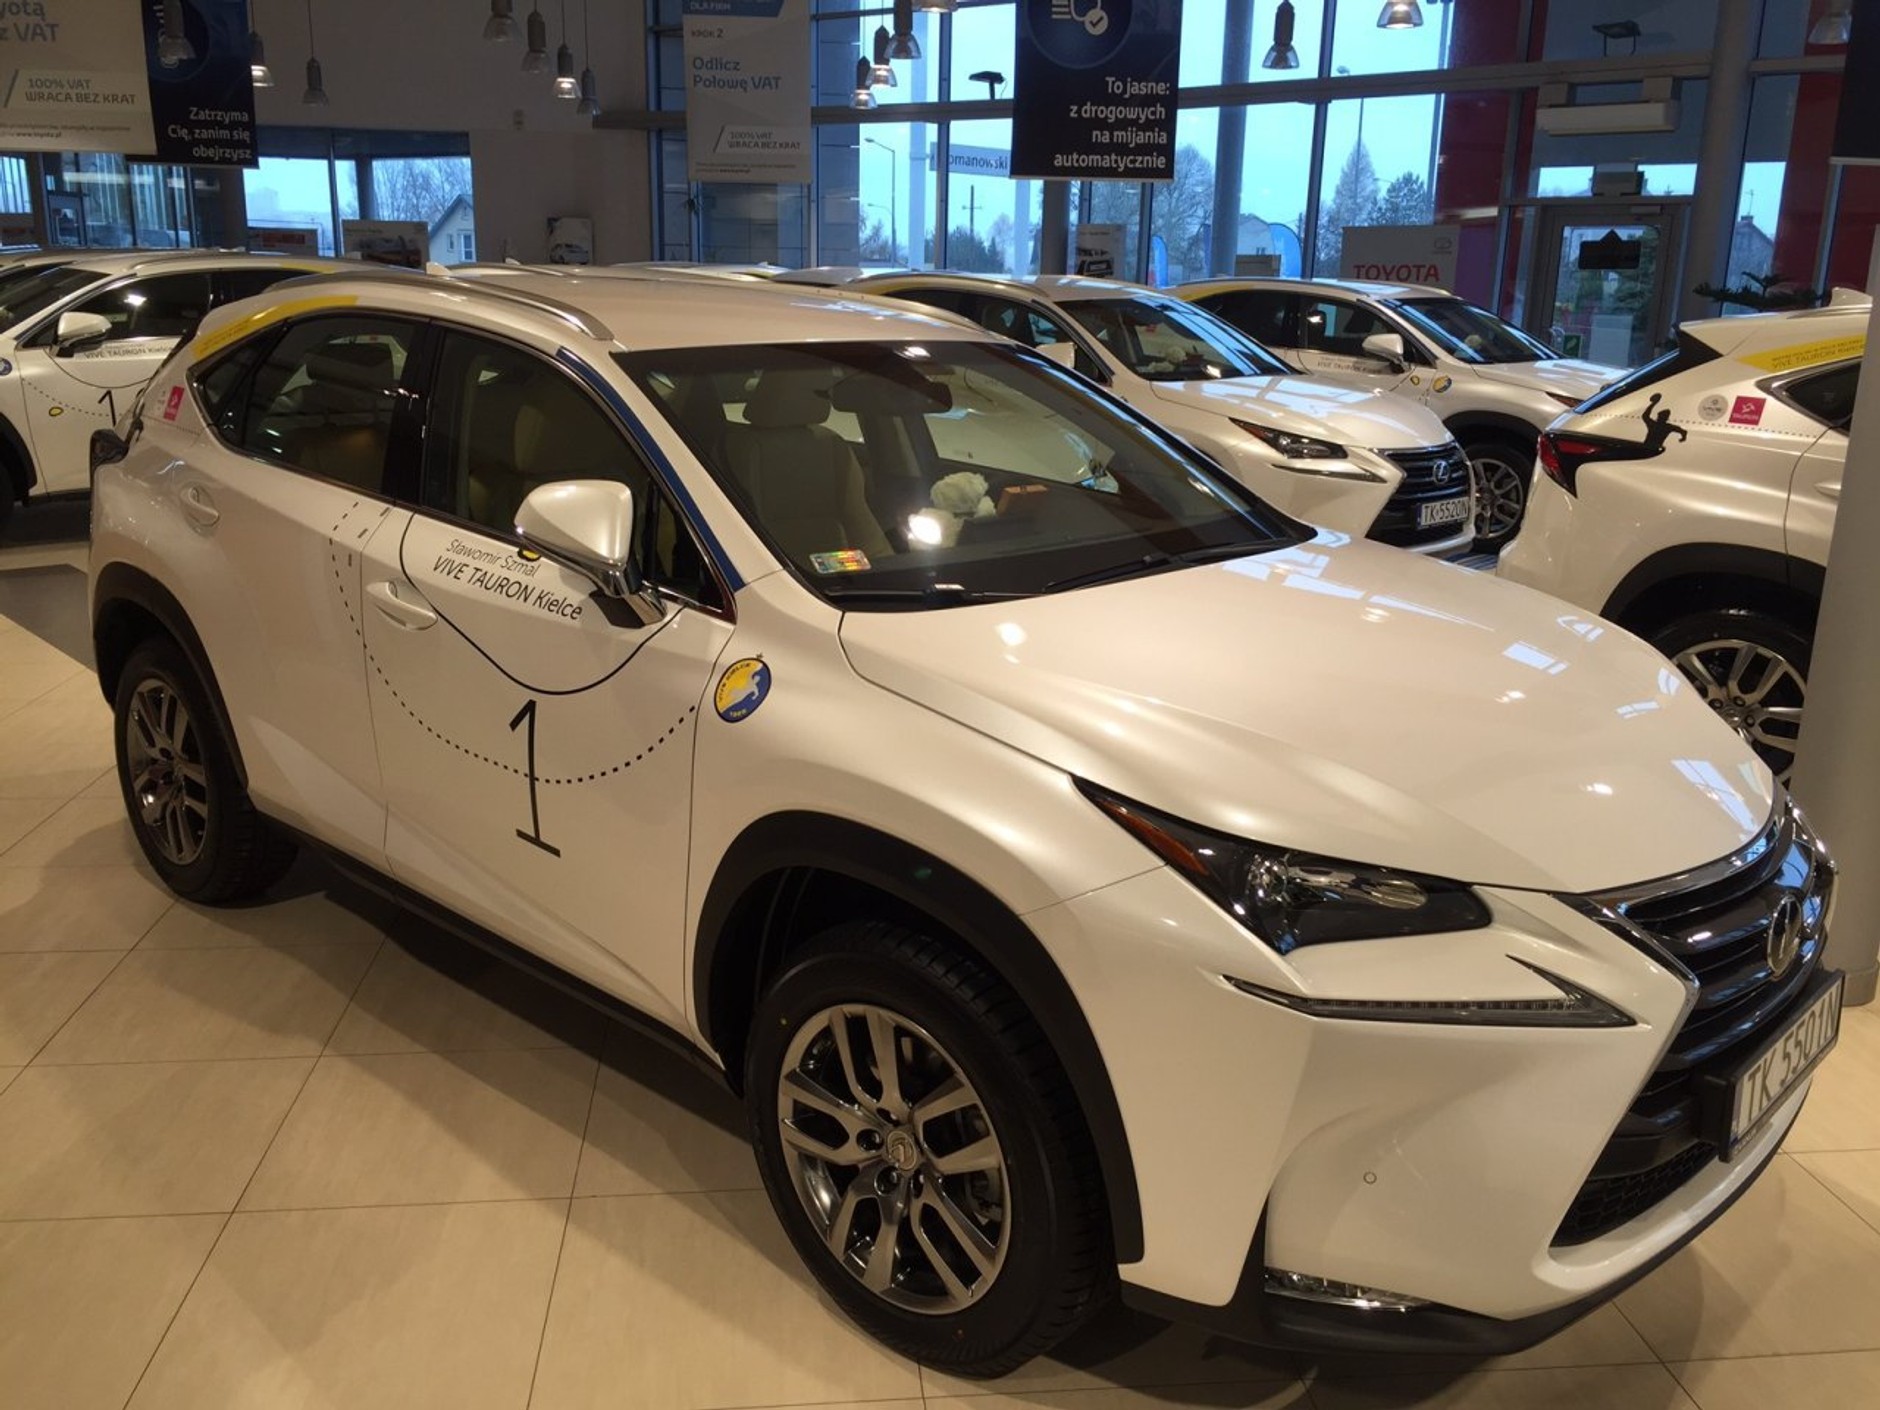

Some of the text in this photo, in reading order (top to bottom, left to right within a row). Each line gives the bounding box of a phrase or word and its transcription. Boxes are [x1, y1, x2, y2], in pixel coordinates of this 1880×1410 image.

[13, 23, 59, 41] VAT
[717, 28, 724, 38] 2
[693, 56, 741, 71] Odlicz
[29, 79, 92, 90] 100% VAT
[693, 74, 782, 92] Połowę VAT
[1105, 77, 1170, 98] To jasne:
[25, 91, 136, 104] WRACA BEZ KRAT
[189, 107, 248, 124] Zatrzyma
[1070, 101, 1166, 123] z drogowych
[168, 124, 250, 143] Cię, zanim się
[1092, 127, 1168, 148] na mijania
[193, 144, 252, 161] obejrzysz
[949, 154, 1009, 170] omanowski
[1054, 152, 1167, 172] automatycznie
[1353, 264, 1440, 282] TOYOTA
[97, 389, 117, 427] 1
[1424, 505, 1437, 523] TK
[446, 538, 541, 578] Sławomir Szmal
[433, 555, 583, 621] VIVE TAURON Kielce
[509, 699, 561, 858] 1
[1748, 1047, 1776, 1122] TK
[1780, 984, 1839, 1087] 5501N
